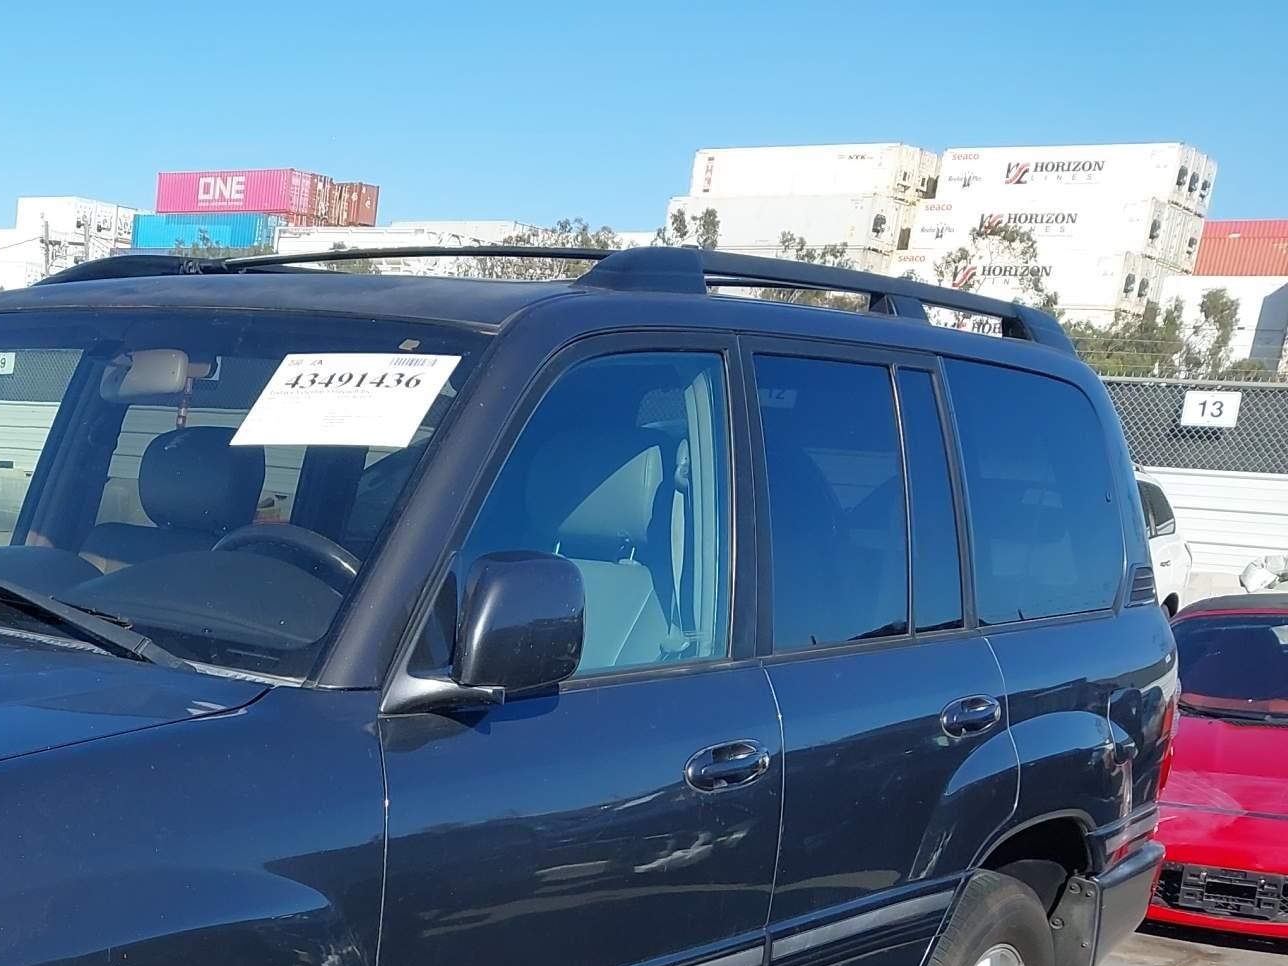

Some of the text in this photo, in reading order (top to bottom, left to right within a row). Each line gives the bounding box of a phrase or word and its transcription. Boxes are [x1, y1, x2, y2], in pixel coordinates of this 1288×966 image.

[952, 152, 980, 161] seaco
[1033, 160, 1105, 173] HORIZON
[1030, 173, 1093, 181] LINES
[197, 175, 246, 200] ONE
[924, 203, 953, 212] seaco
[1008, 212, 1078, 224] HORIZON
[898, 255, 926, 263] seaco
[980, 265, 1052, 277] HORIZON
[0, 357, 6, 369] 9
[284, 371, 426, 389] 43491436
[1198, 400, 1224, 418] 13
